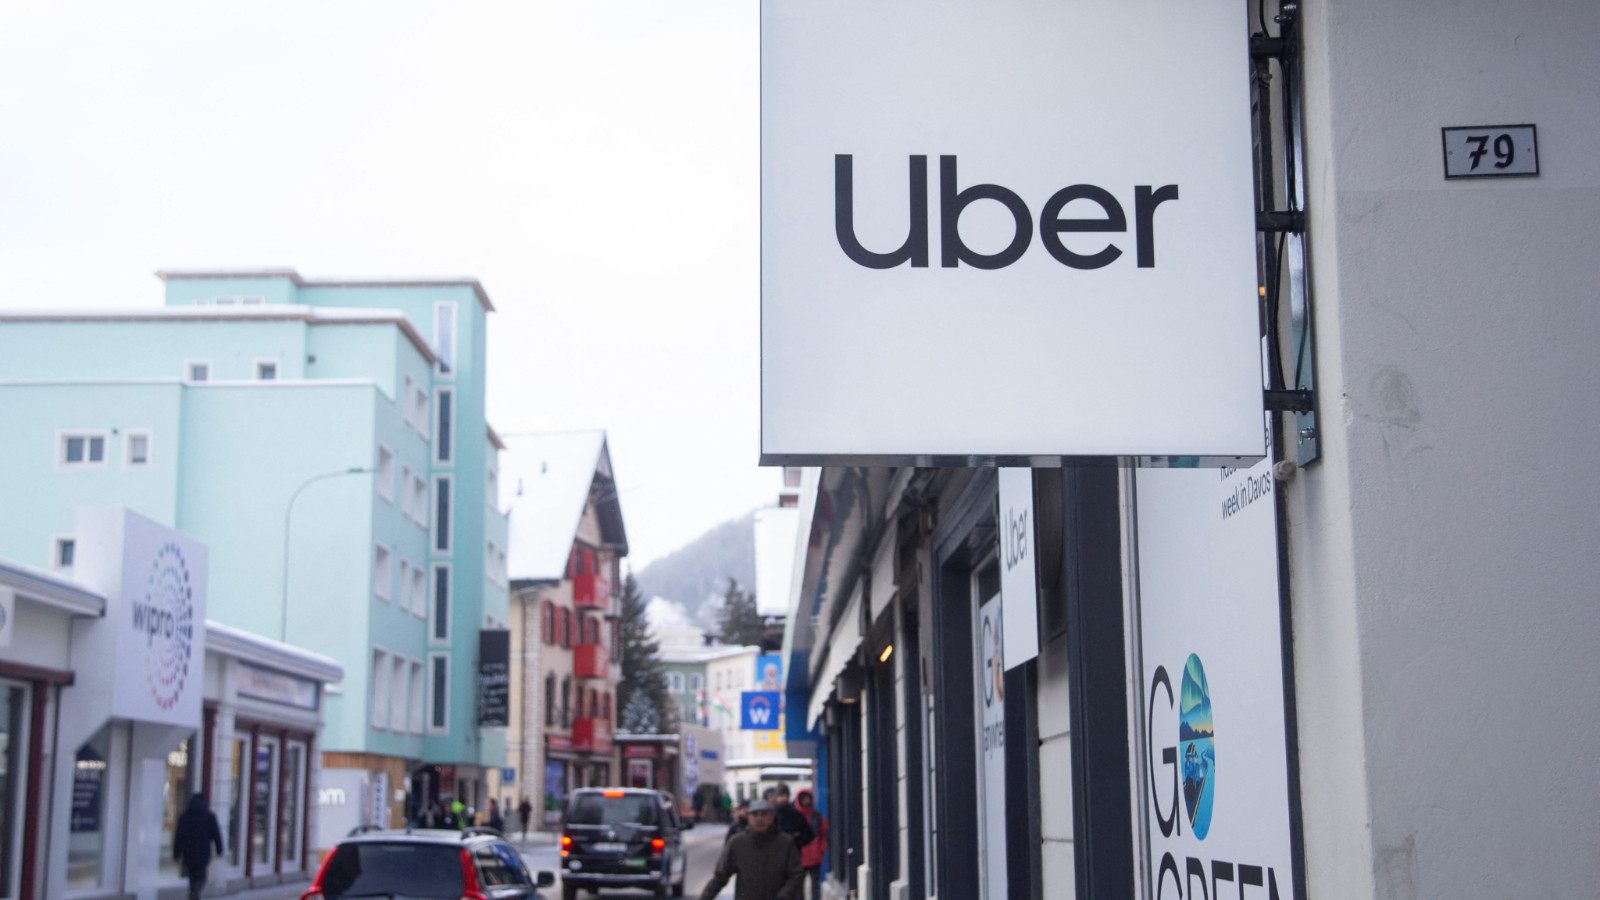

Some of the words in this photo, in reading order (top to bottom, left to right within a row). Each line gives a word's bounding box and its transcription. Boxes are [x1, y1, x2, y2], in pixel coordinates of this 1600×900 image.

[1466, 134, 1514, 171] 79
[834, 153, 1179, 270] Uber
[1221, 486, 1240, 520] week
[1240, 482, 1247, 508] in
[1247, 471, 1271, 504] Davos
[1005, 507, 1028, 572] Uber
[132, 593, 175, 648] wipro
[1149, 653, 1215, 841] GO
